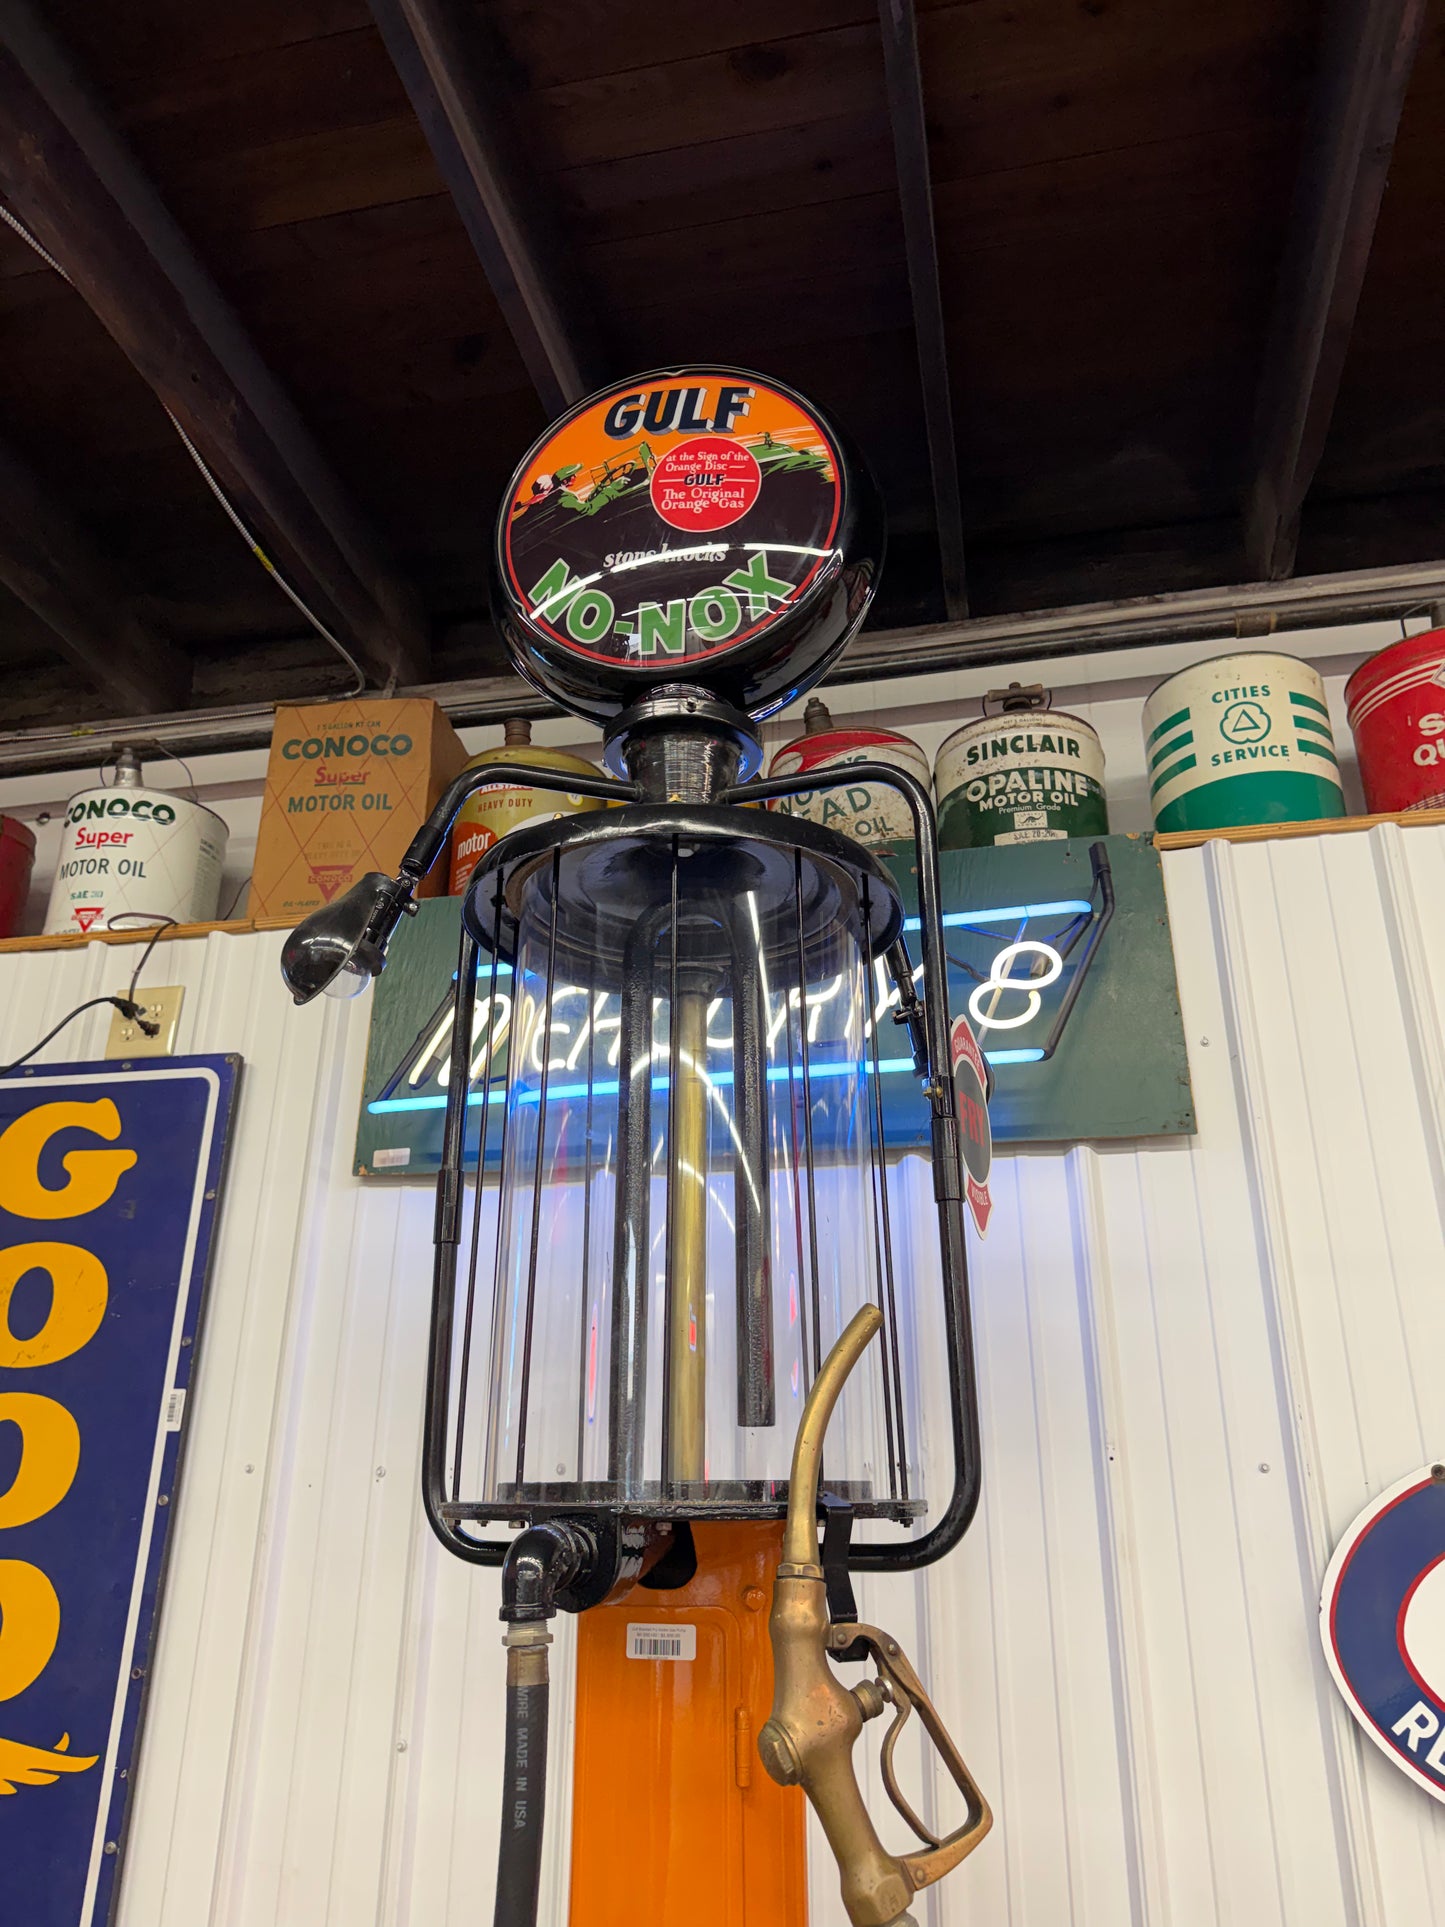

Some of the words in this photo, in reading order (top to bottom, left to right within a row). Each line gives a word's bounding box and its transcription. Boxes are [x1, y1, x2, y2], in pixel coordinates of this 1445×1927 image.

[603, 386, 756, 441] GULF
[665, 453, 677, 463] at
[679, 451, 695, 461] the
[697, 451, 719, 464] Sign
[720, 450, 734, 461] of
[734, 452, 750, 462] the
[665, 462, 702, 474] Orange
[704, 461, 728, 471] Disc
[684, 473, 727, 487] GULF
[663, 488, 686, 500] The
[690, 487, 745, 503] Original
[661, 499, 710, 514] Orange
[718, 498, 745, 509] Gas
[528, 550, 796, 657] NO-NOX
[1211, 685, 1271, 703] CITIES
[282, 733, 413, 760] CONOCO
[966, 734, 1080, 766] SINCLAIR
[1211, 745, 1289, 767] SERVICE
[314, 766, 372, 786] Super
[966, 769, 1088, 803] OPALINE
[288, 795, 355, 813] MOTOR
[362, 793, 393, 811] OIL
[478, 799, 505, 813] HEAVY
[508, 797, 533, 809] DUTY
[979, 791, 1044, 812] MOTOR
[1051, 791, 1079, 807] OIL
[998, 804, 1033, 814] Premium
[1036, 802, 1061, 811] Grade
[854, 816, 895, 837] OIL
[75, 826, 134, 850] Super
[457, 831, 492, 860] motor
[59, 858, 110, 881] MOTOR
[118, 859, 147, 879] OIL
[70, 890, 89, 901] SAE
[967, 940, 1063, 1030] 8
[958, 1090, 985, 1148] FRY
[517, 1685, 529, 1719] WIRE
[516, 1727, 529, 1769] MADE
[515, 1776, 528, 1792] IN
[514, 1800, 527, 1830] USA
